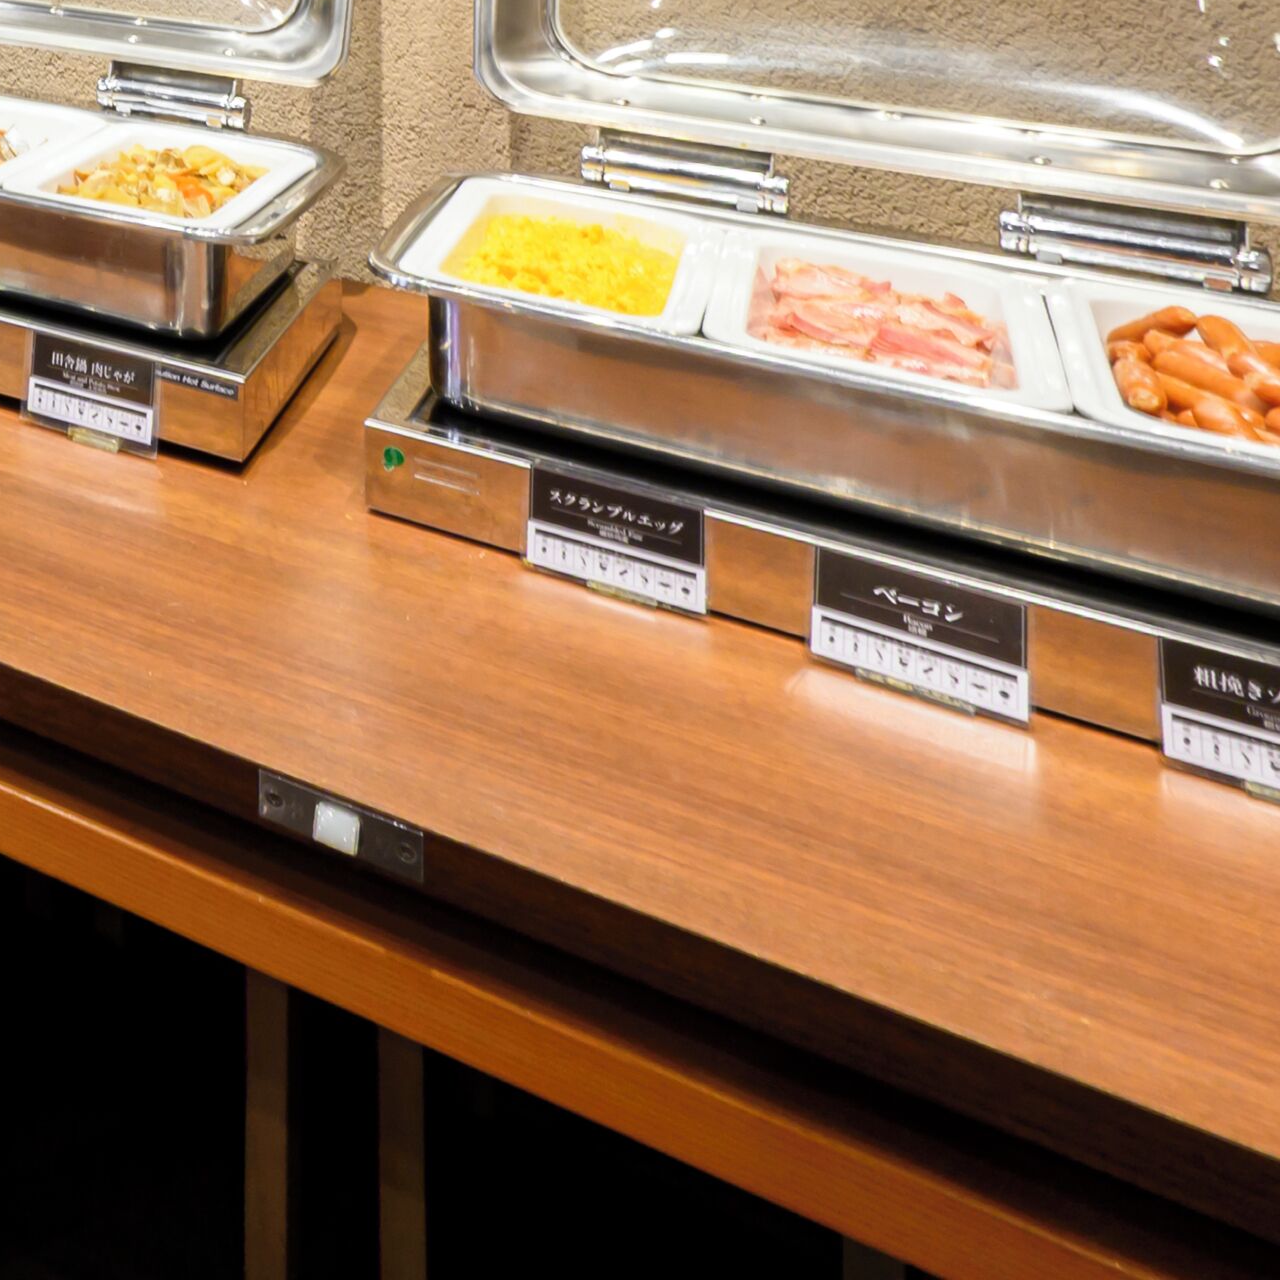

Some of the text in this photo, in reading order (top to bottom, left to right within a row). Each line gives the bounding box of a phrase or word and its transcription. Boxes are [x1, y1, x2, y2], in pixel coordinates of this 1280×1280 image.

[91, 361, 136, 386] 肉じゃが
[182, 375, 199, 387] Hot
[200, 379, 235, 396] Surface
[549, 488, 684, 535] スクランブルエッグ
[873, 585, 963, 623] ベーコン
